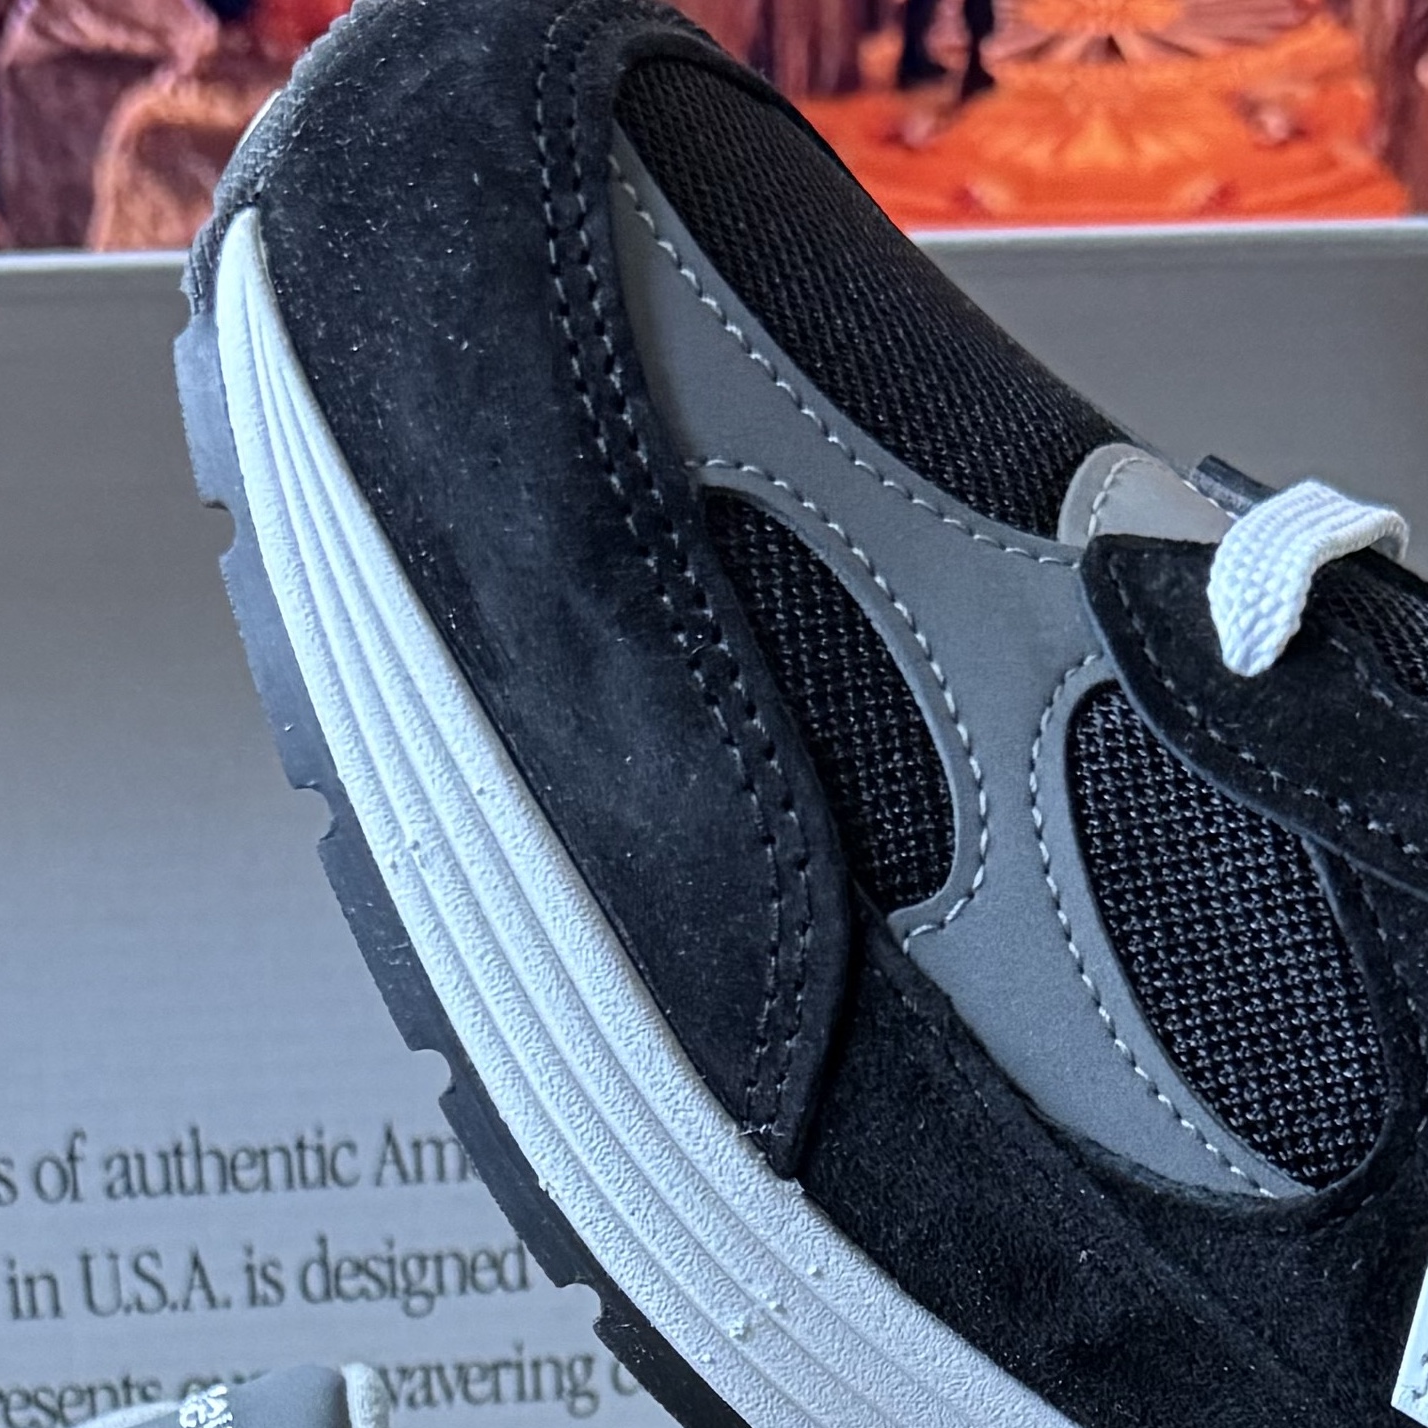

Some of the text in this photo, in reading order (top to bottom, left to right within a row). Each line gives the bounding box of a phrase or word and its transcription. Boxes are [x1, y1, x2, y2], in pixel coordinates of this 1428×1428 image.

[32, 1129, 86, 1202] of
[103, 1123, 360, 1200] authentic
[373, 1122, 480, 1187] Am
[7, 1257, 64, 1321] in
[78, 1246, 232, 1318] U.S.A.
[242, 1243, 286, 1308] is
[298, 1231, 530, 1319] designed
[374, 1338, 601, 1419] wavering
